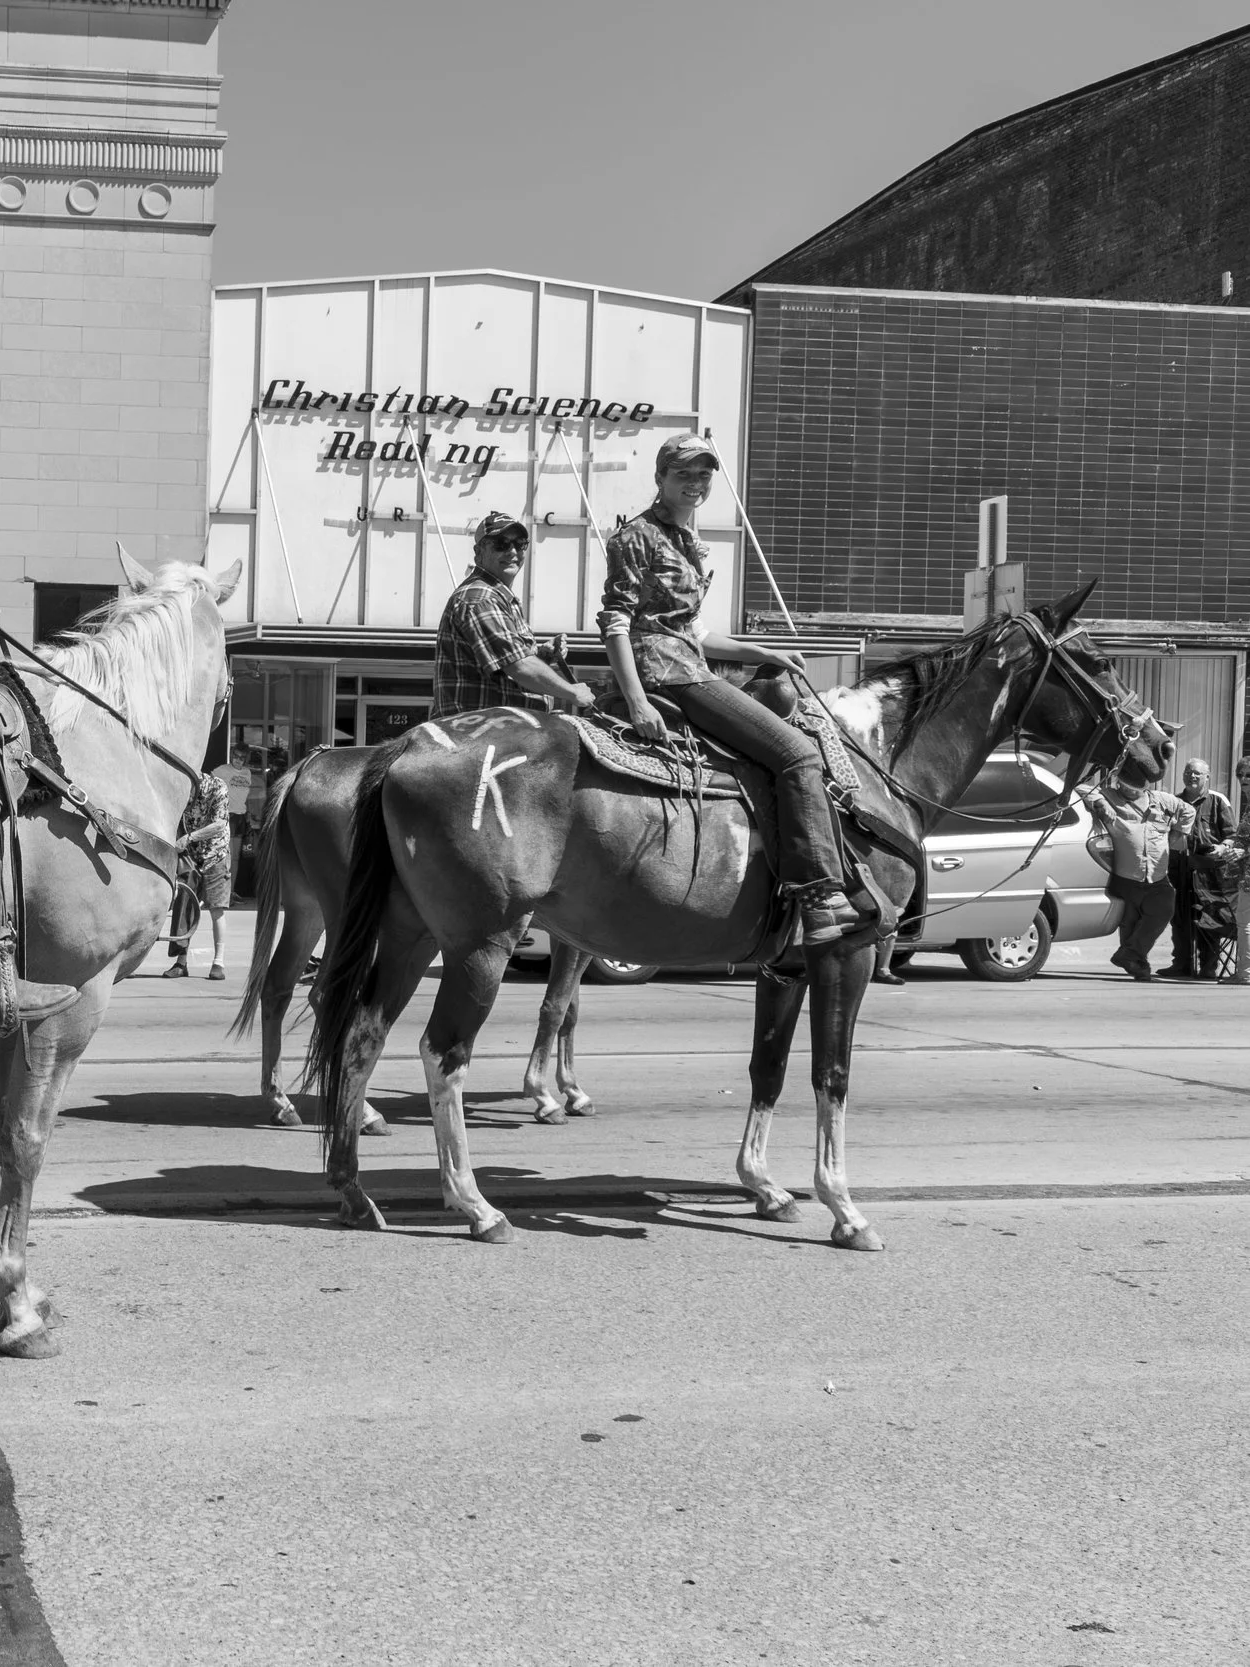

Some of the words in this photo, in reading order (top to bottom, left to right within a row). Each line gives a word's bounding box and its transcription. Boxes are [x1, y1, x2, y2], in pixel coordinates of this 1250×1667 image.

[262, 378, 470, 420] Christian
[485, 387, 655, 424] Science
[471, 744, 528, 838] K
